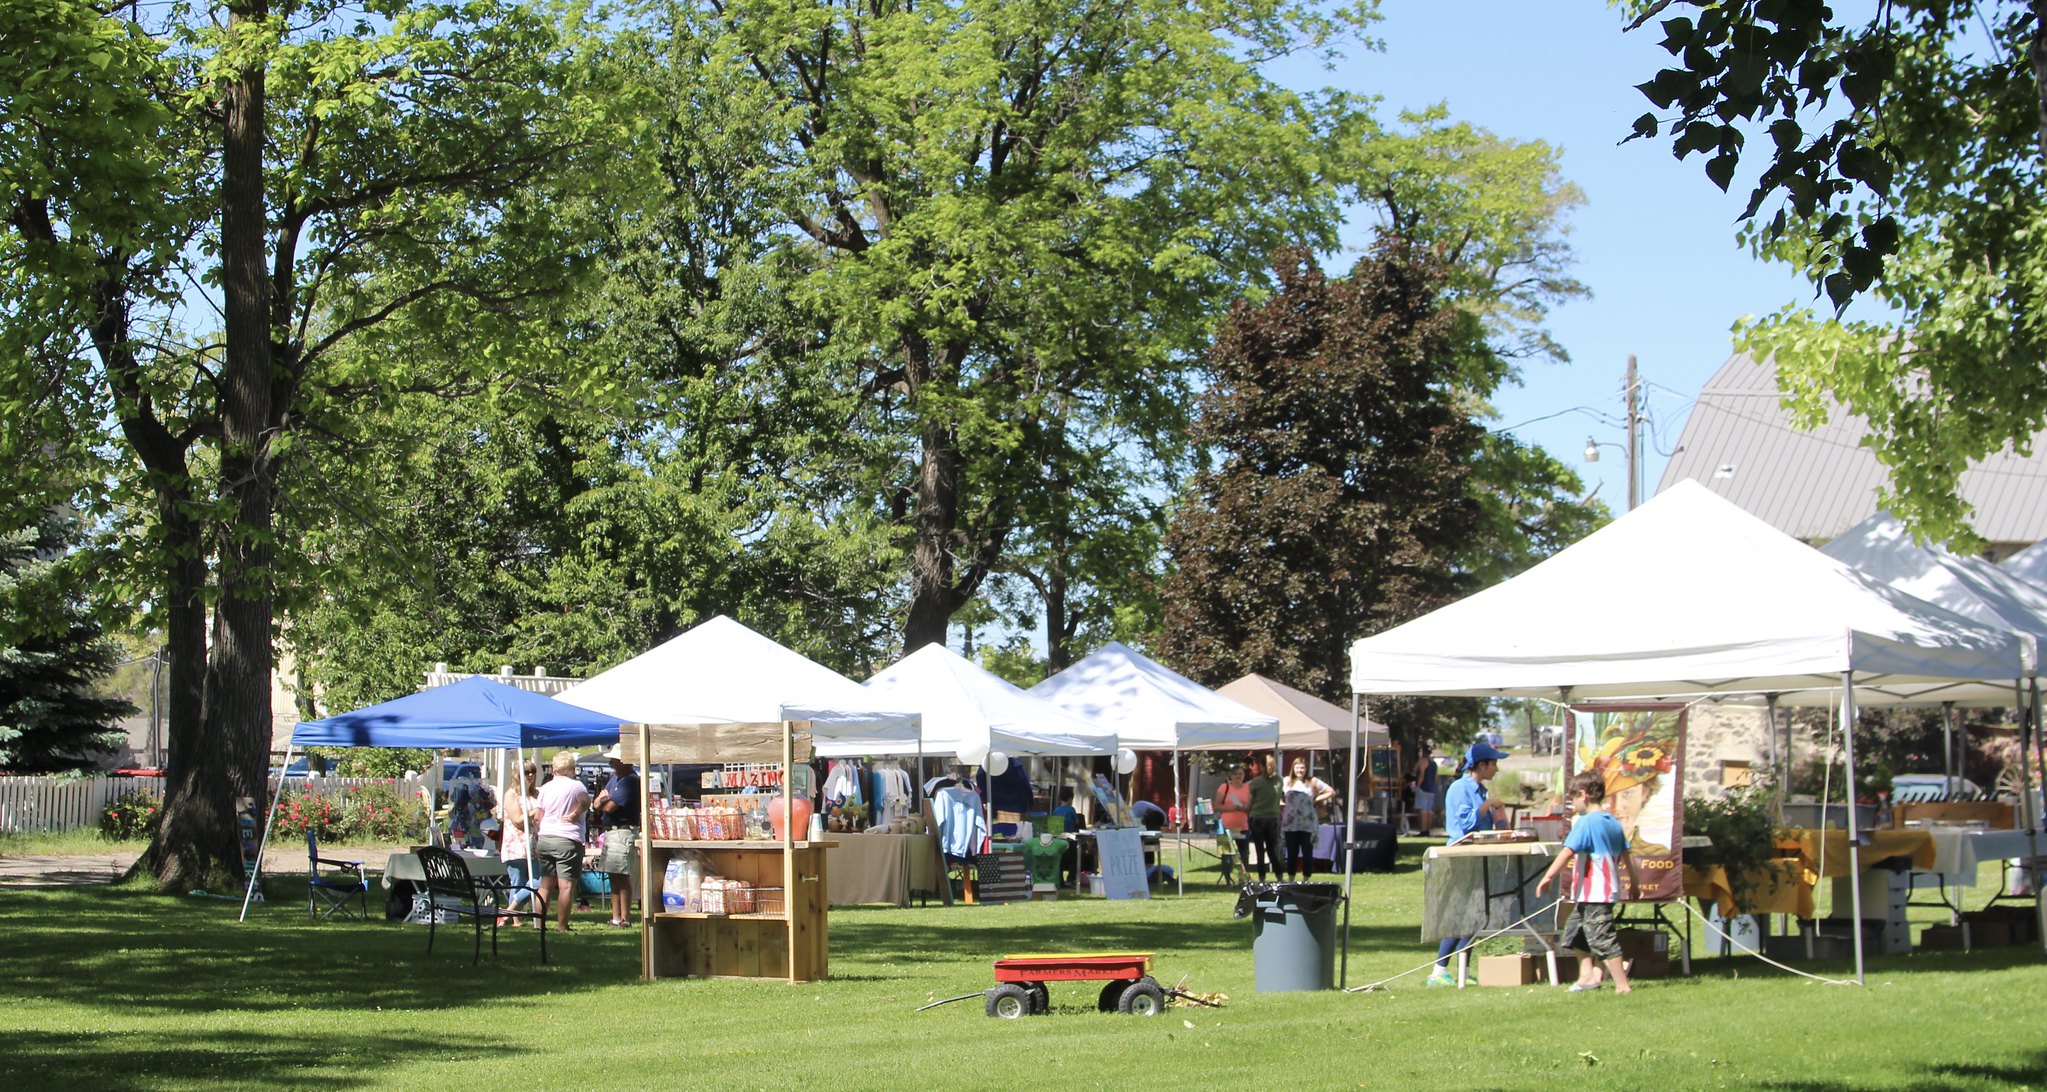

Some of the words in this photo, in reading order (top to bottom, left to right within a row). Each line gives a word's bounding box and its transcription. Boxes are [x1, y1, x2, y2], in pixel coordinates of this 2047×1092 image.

[1109, 854, 1141, 877] PRIZE
[1641, 859, 1674, 869] FOOD
[1020, 969, 1072, 977] FARMERS
